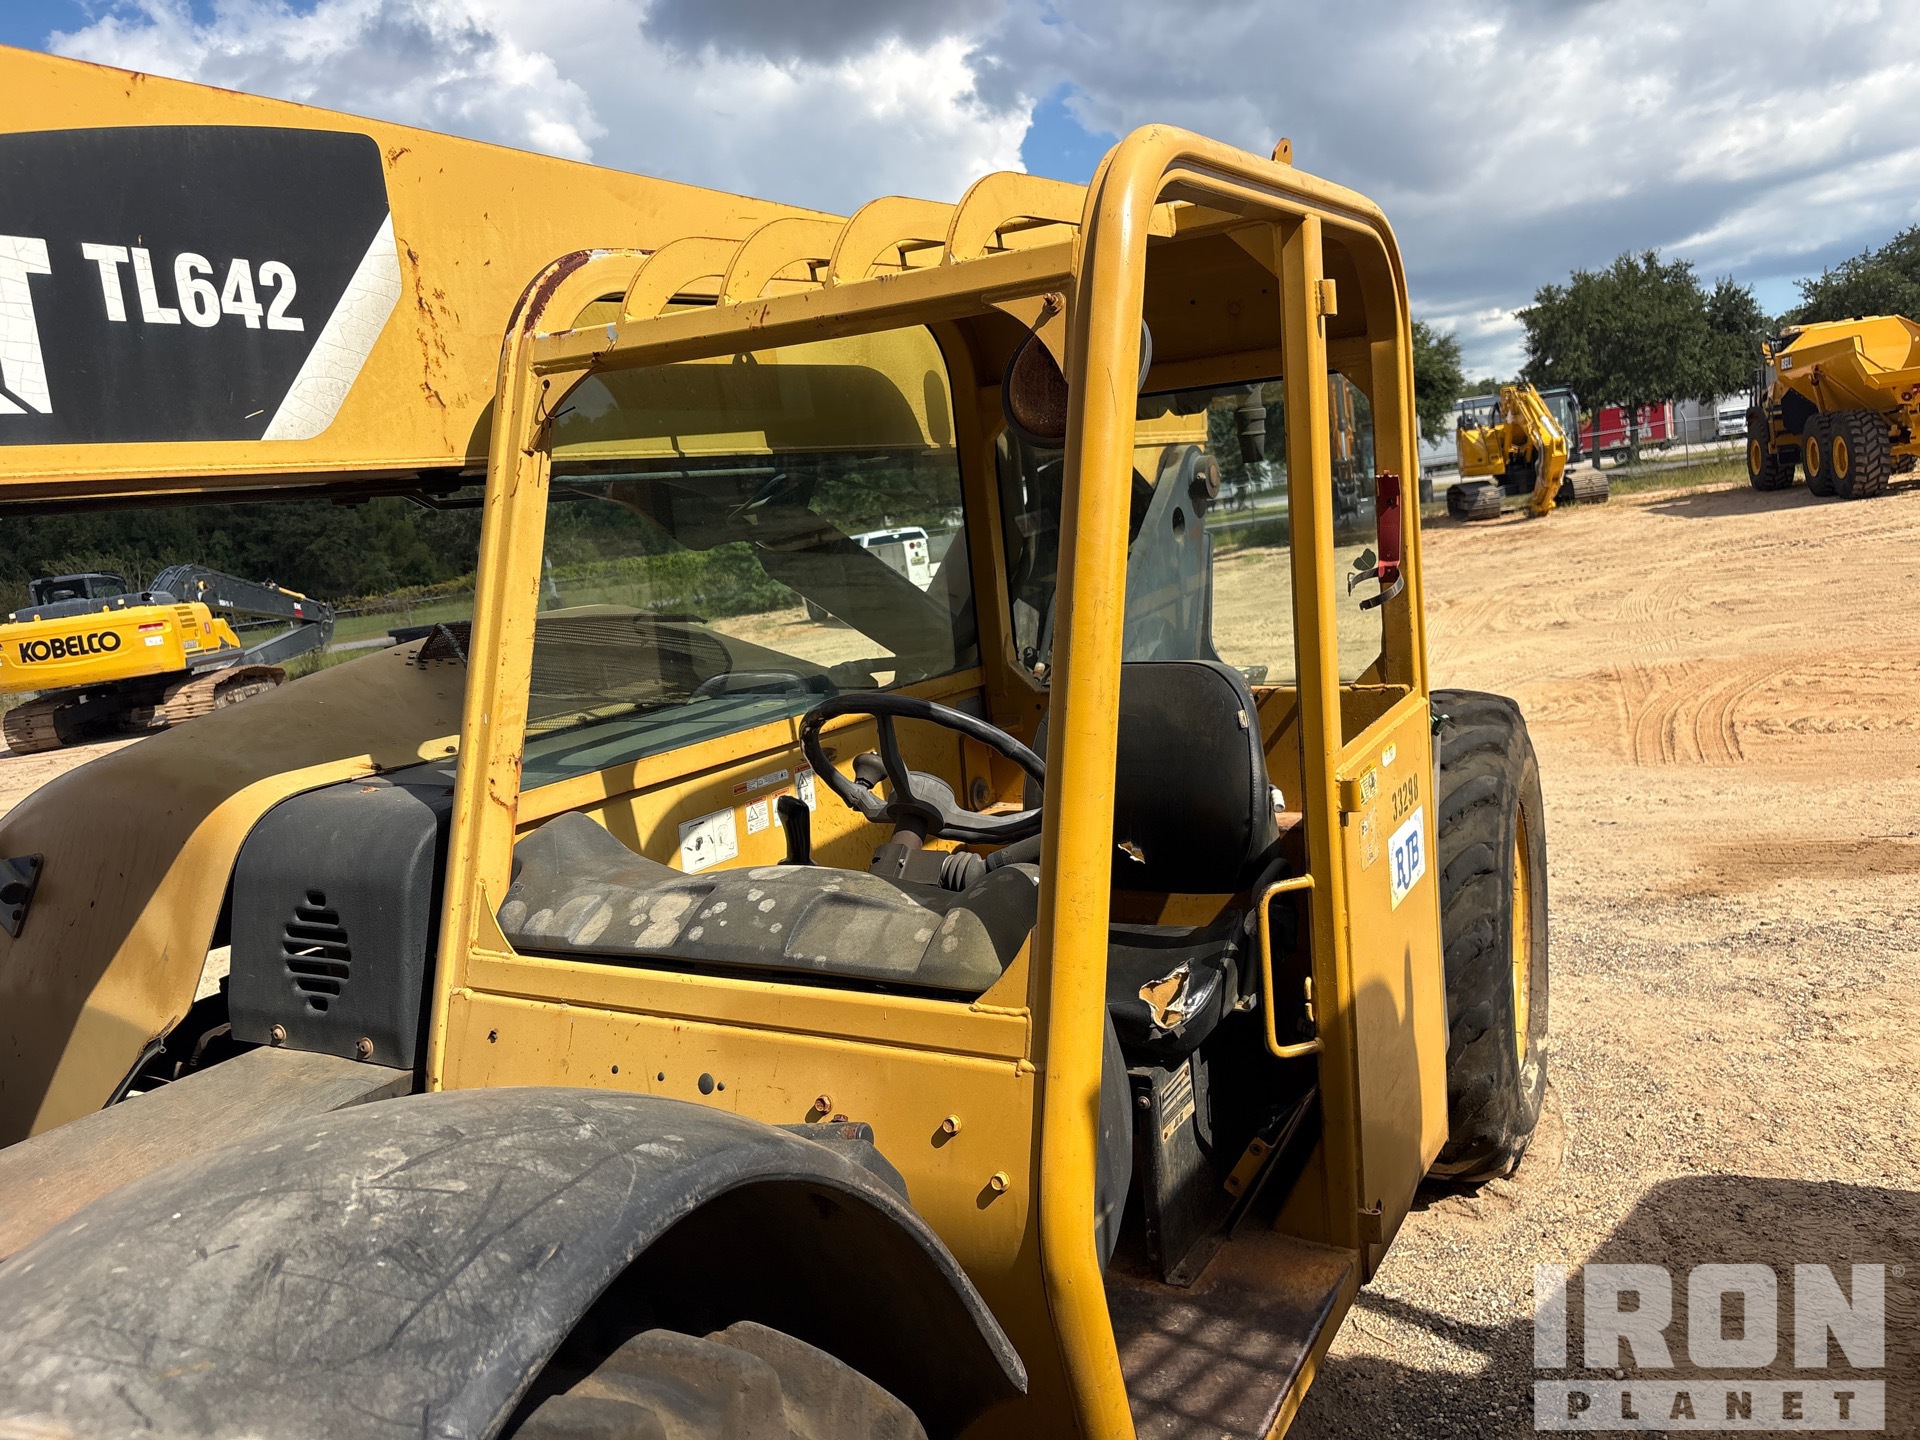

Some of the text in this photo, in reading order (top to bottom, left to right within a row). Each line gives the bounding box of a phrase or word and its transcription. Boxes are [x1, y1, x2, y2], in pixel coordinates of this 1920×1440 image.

[81, 242, 304, 331] TL642
[19, 631, 121, 663] KOBELCO
[1392, 773, 1418, 821] 33298
[1396, 830, 1419, 889] RJB
